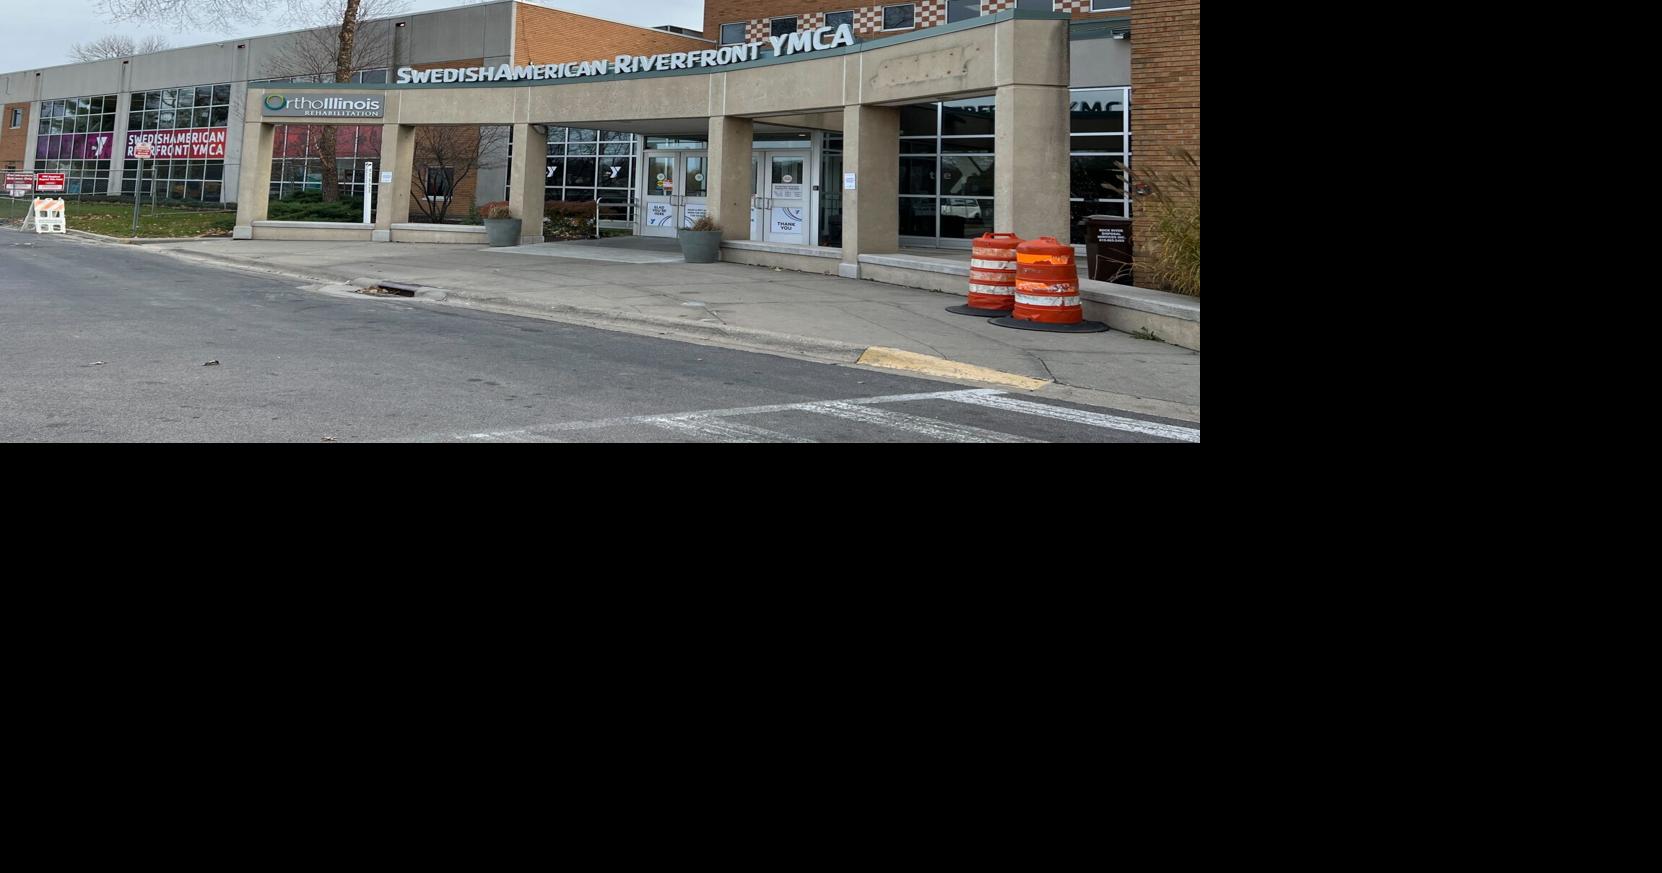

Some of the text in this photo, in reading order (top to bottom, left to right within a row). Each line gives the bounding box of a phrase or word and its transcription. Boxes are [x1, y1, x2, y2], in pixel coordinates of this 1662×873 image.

[614, 42, 763, 74] RIVERFRONT
[769, 24, 854, 57] YMCA
[264, 94, 380, 111] OrthoIllinois
[128, 131, 225, 145] SWEDISHAMERICAN
[127, 144, 189, 157] RRFRONT
[192, 143, 224, 156] YMCA
